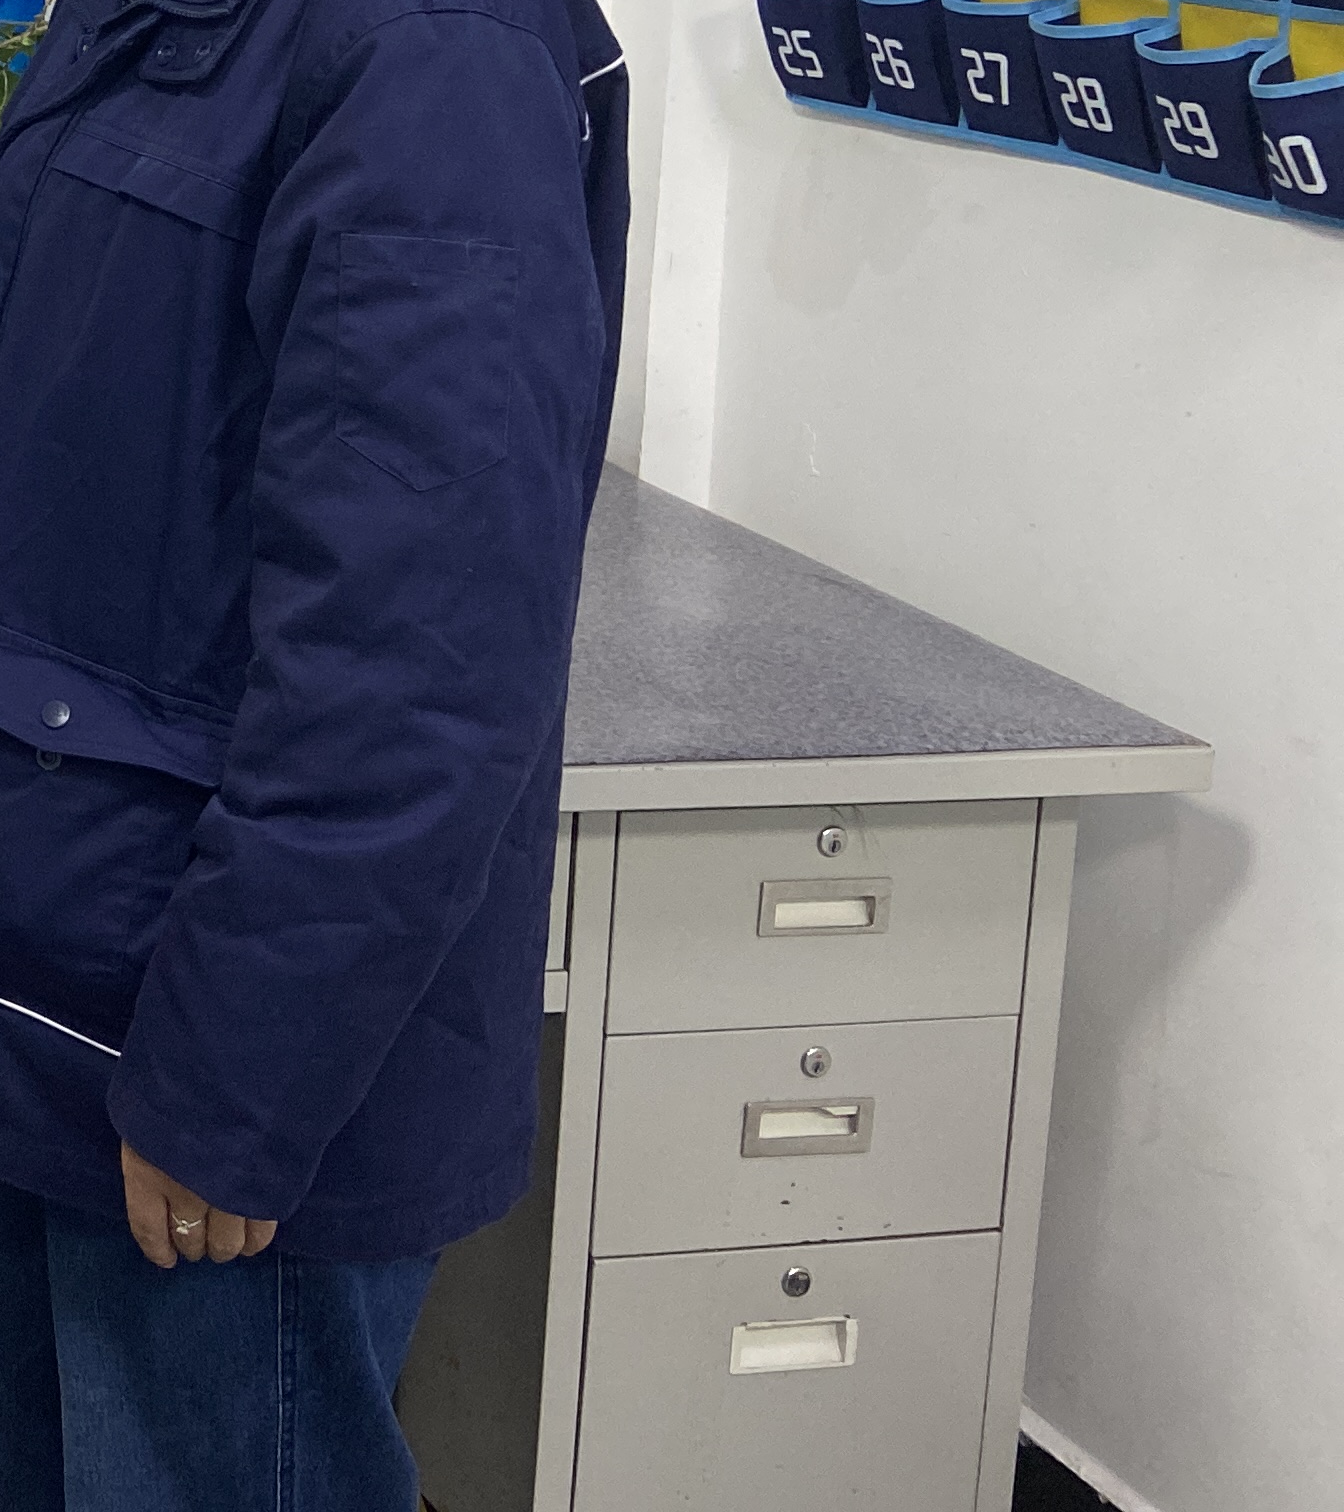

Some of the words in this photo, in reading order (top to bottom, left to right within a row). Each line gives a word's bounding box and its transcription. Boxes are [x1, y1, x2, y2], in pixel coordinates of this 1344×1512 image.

[772, 27, 823, 80] 25
[866, 33, 914, 89] 26
[961, 48, 1009, 105] 27
[1053, 72, 1112, 131] 28
[1156, 96, 1218, 158] 29
